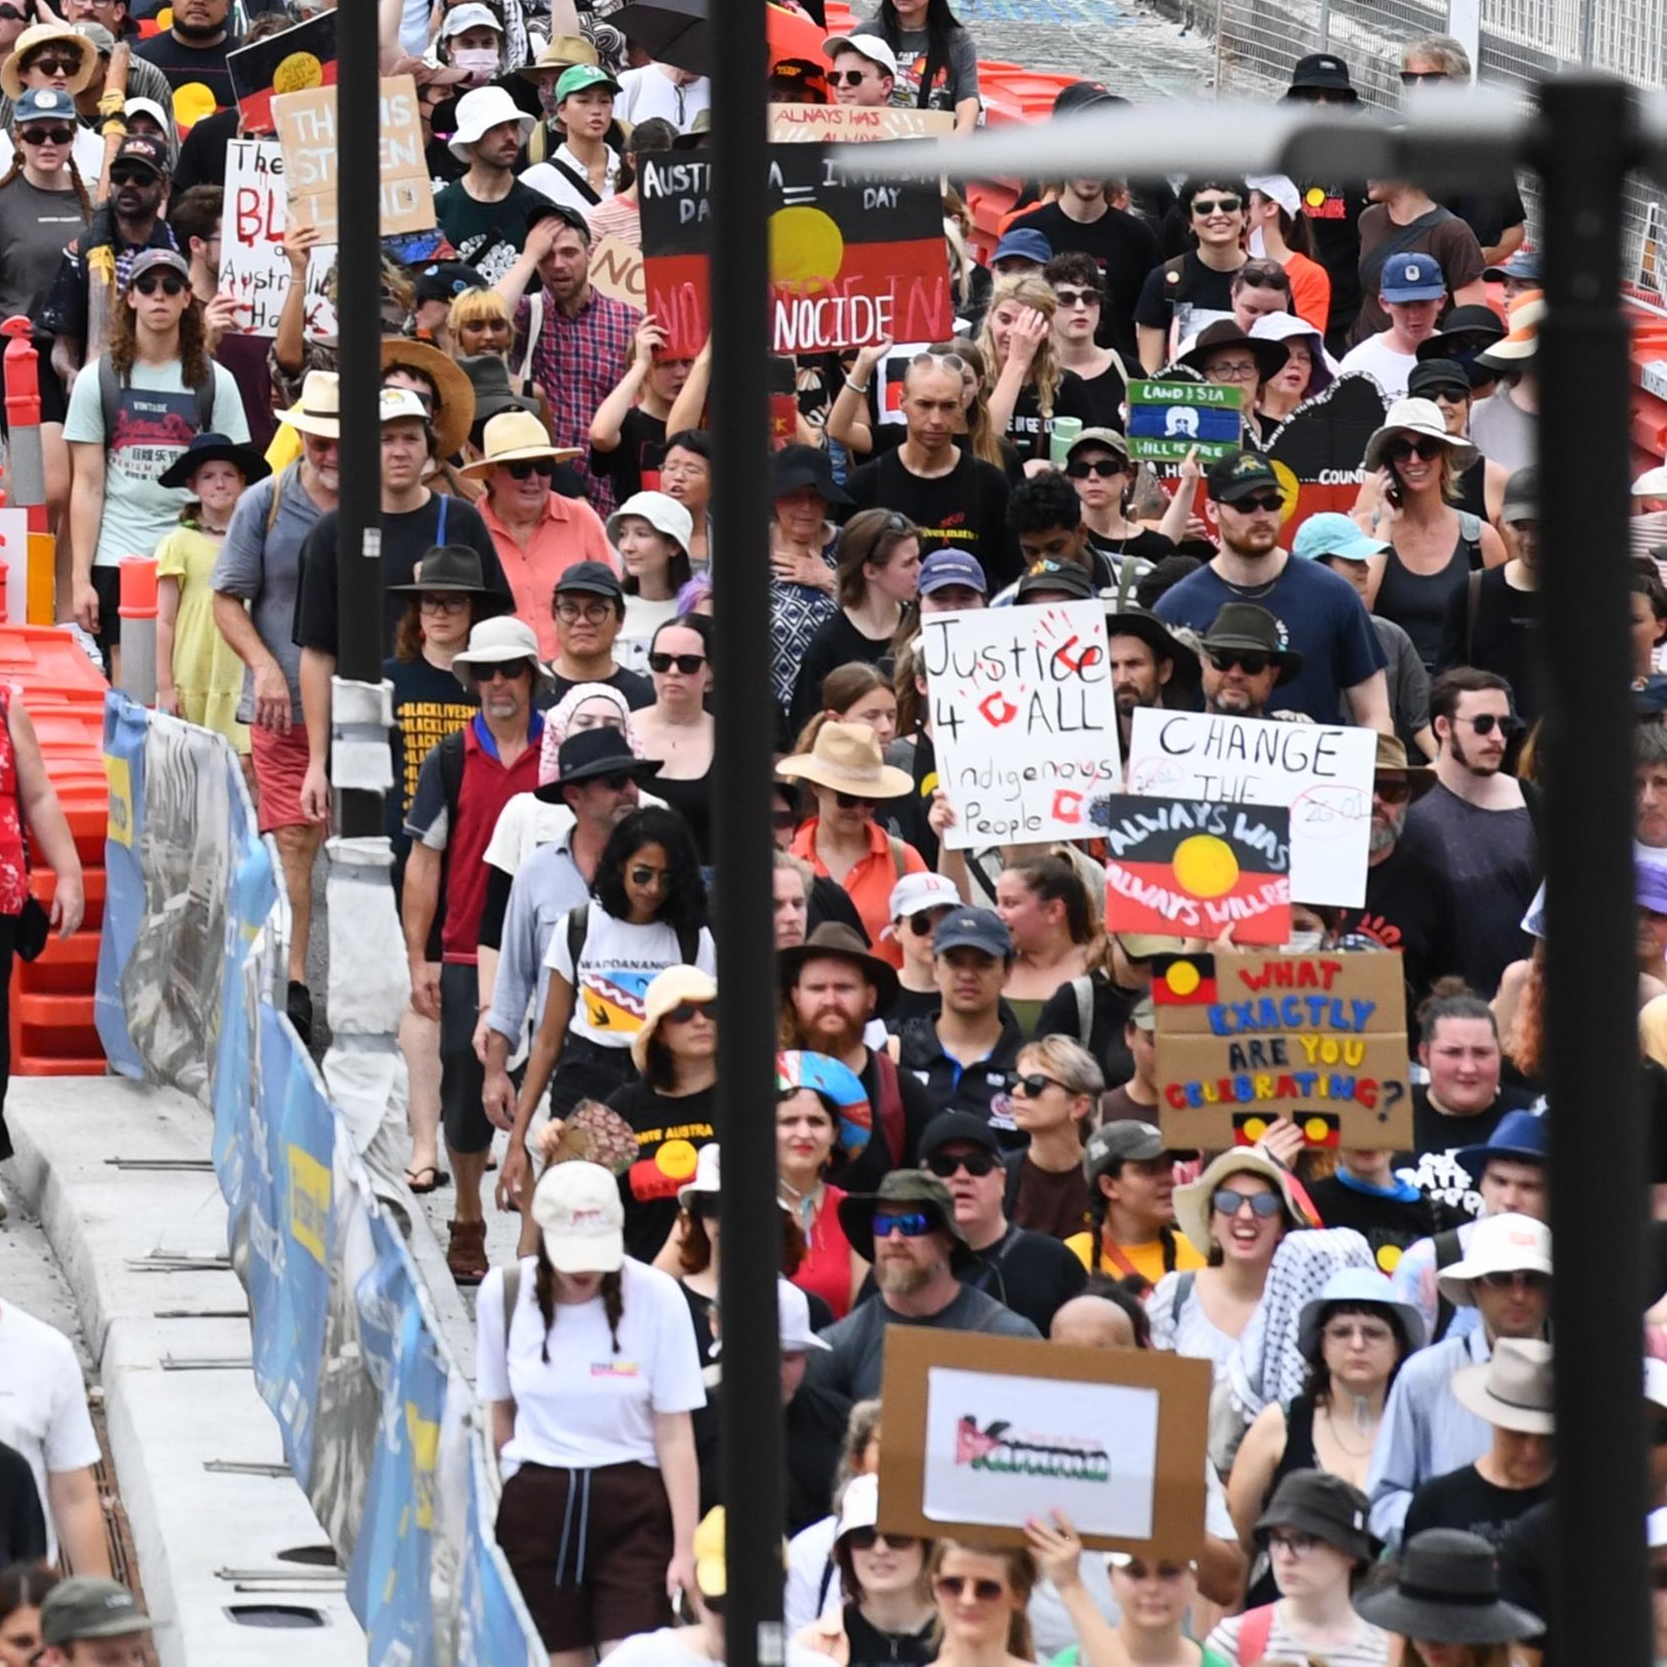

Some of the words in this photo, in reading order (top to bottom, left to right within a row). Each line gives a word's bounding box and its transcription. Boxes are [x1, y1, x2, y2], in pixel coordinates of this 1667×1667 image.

[862, 189, 899, 210] DAY
[1143, 385, 1183, 400] LAND
[1135, 442, 1169, 455] WILL
[928, 620, 1106, 684] Justice
[936, 701, 965, 742] 4
[1027, 688, 1103, 731] ALL
[1160, 716, 1345, 777] CHANGE
[945, 759, 1114, 801] Indigenous
[964, 803, 1042, 836] People
[1110, 804, 1229, 856] ALWAYS
[1237, 960, 1340, 991] WHAT
[1206, 996, 1374, 1036] EXACTLY
[1227, 1037, 1289, 1070] ARE
[1297, 1036, 1364, 1069] YOU
